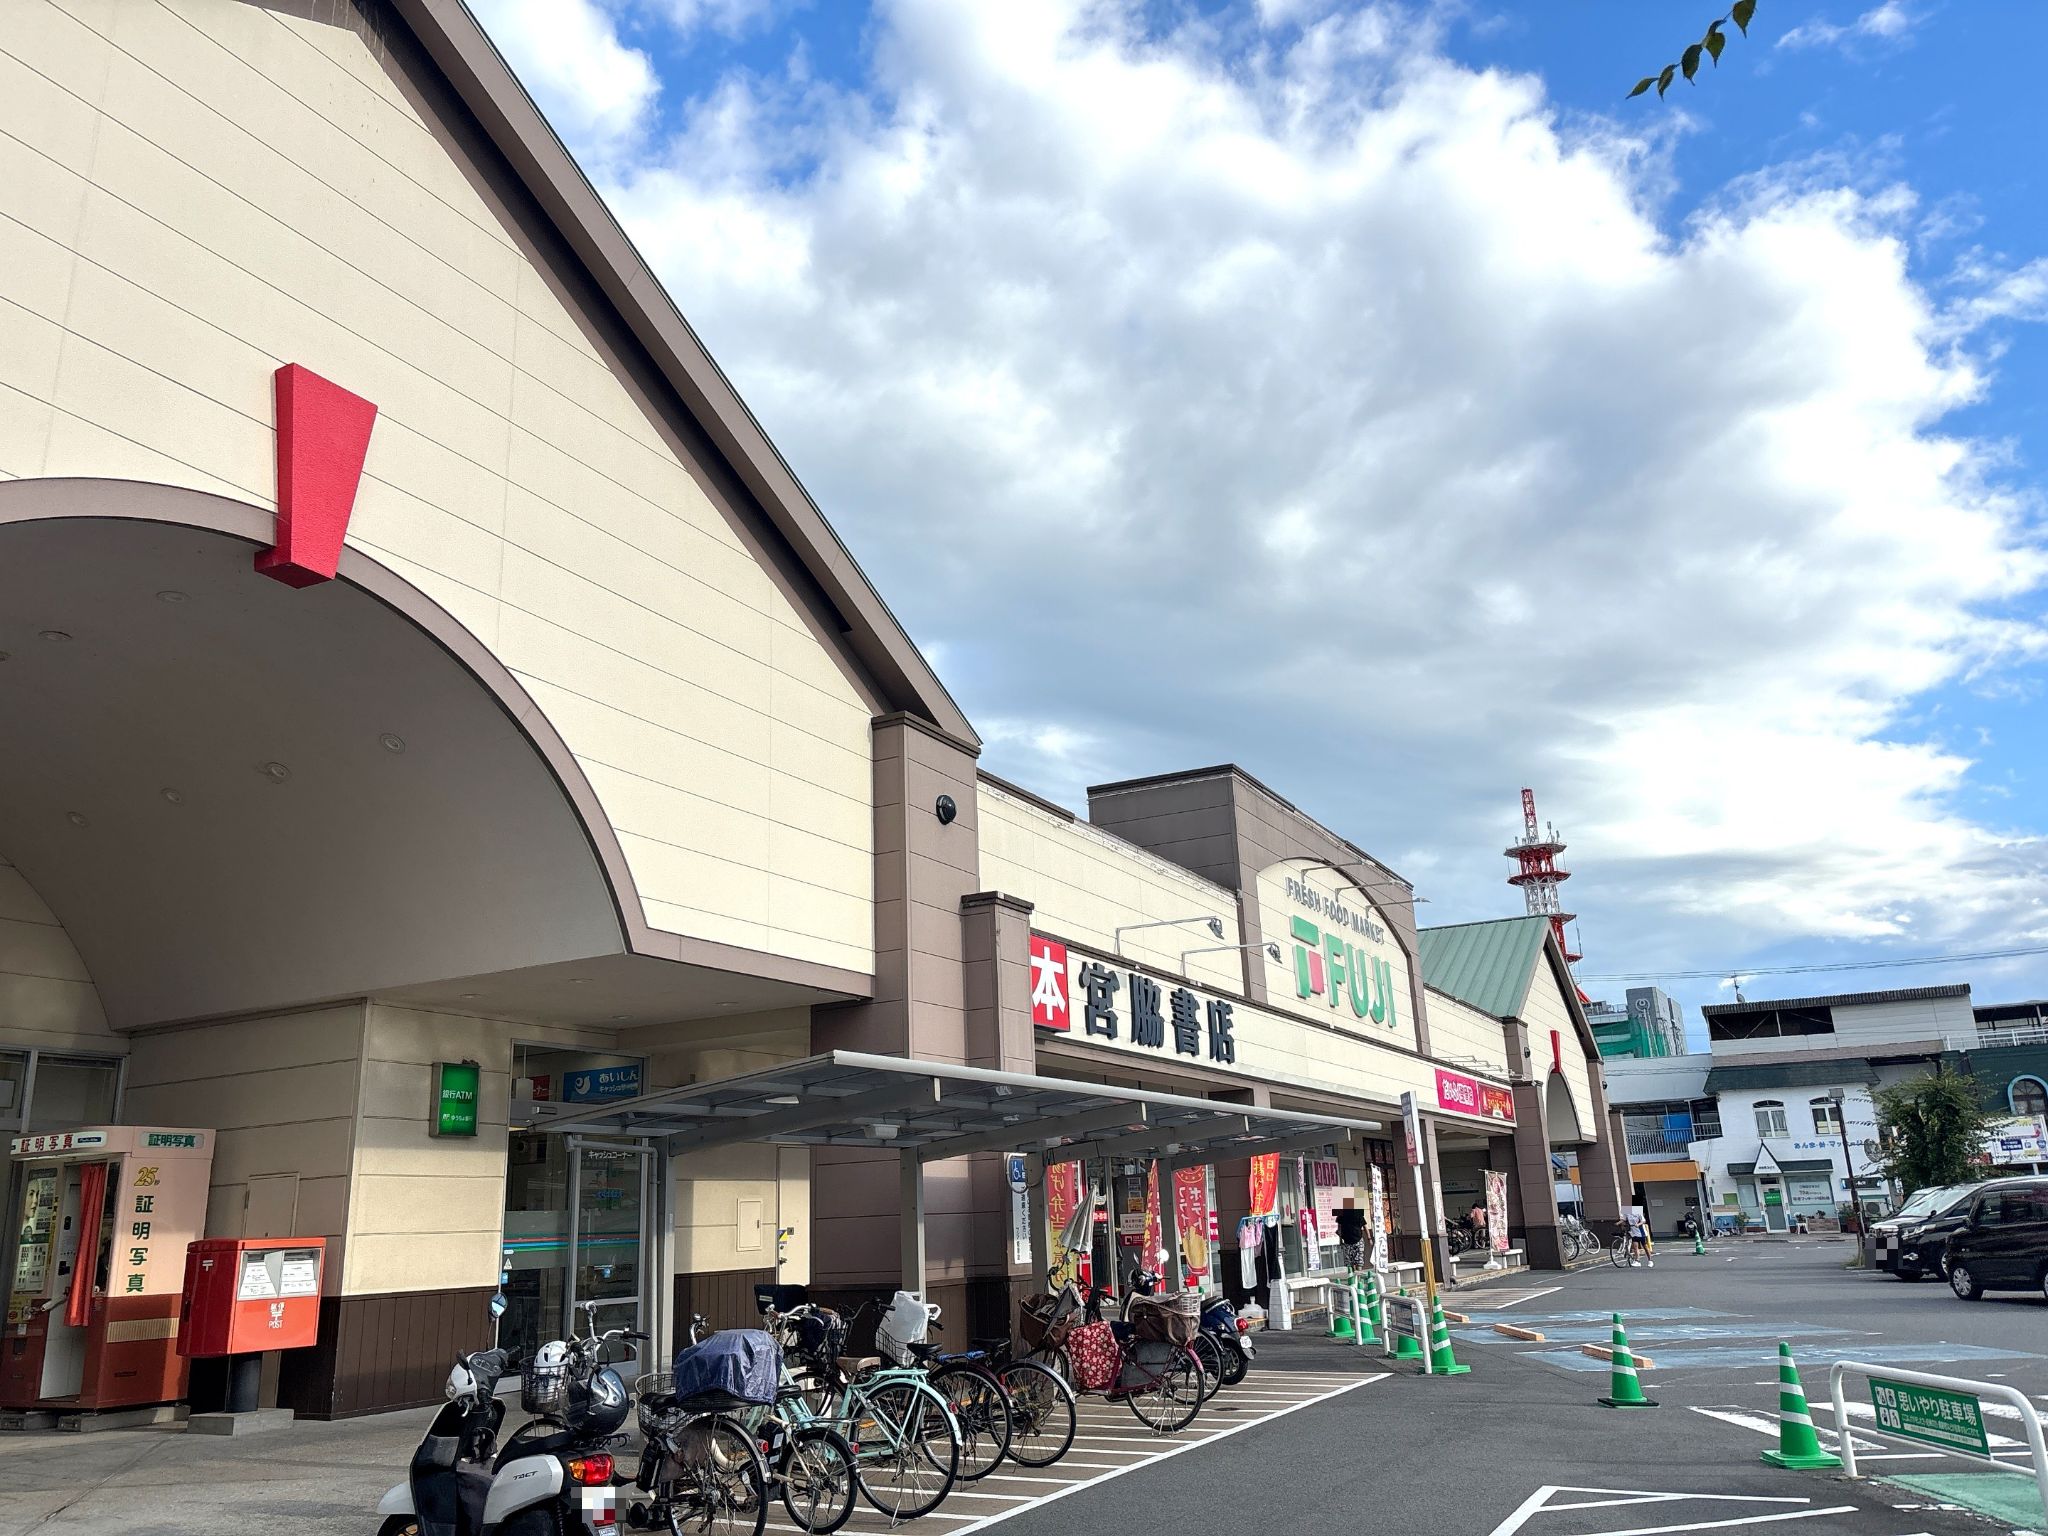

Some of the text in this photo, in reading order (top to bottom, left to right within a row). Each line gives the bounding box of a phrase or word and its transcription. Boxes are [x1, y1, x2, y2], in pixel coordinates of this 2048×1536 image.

[1285, 876, 1385, 946] FRESH FOOD MARKET
[1031, 946, 1066, 1021] 本
[1322, 932, 1397, 1028] FUJI
[1079, 961, 1236, 1064] 宮脇書店
[442, 1089, 473, 1101] 銀行ATM
[20, 1134, 74, 1153] 証明写真
[147, 1133, 196, 1148] 証明写真
[588, 1150, 633, 1160] キャッシュコーナー
[126, 1195, 155, 1293] 証明写真
[268, 1320, 283, 1329] POST
[1898, 1391, 1977, 1426] 思いやり駐車場
[513, 1471, 538, 1480] TACT
